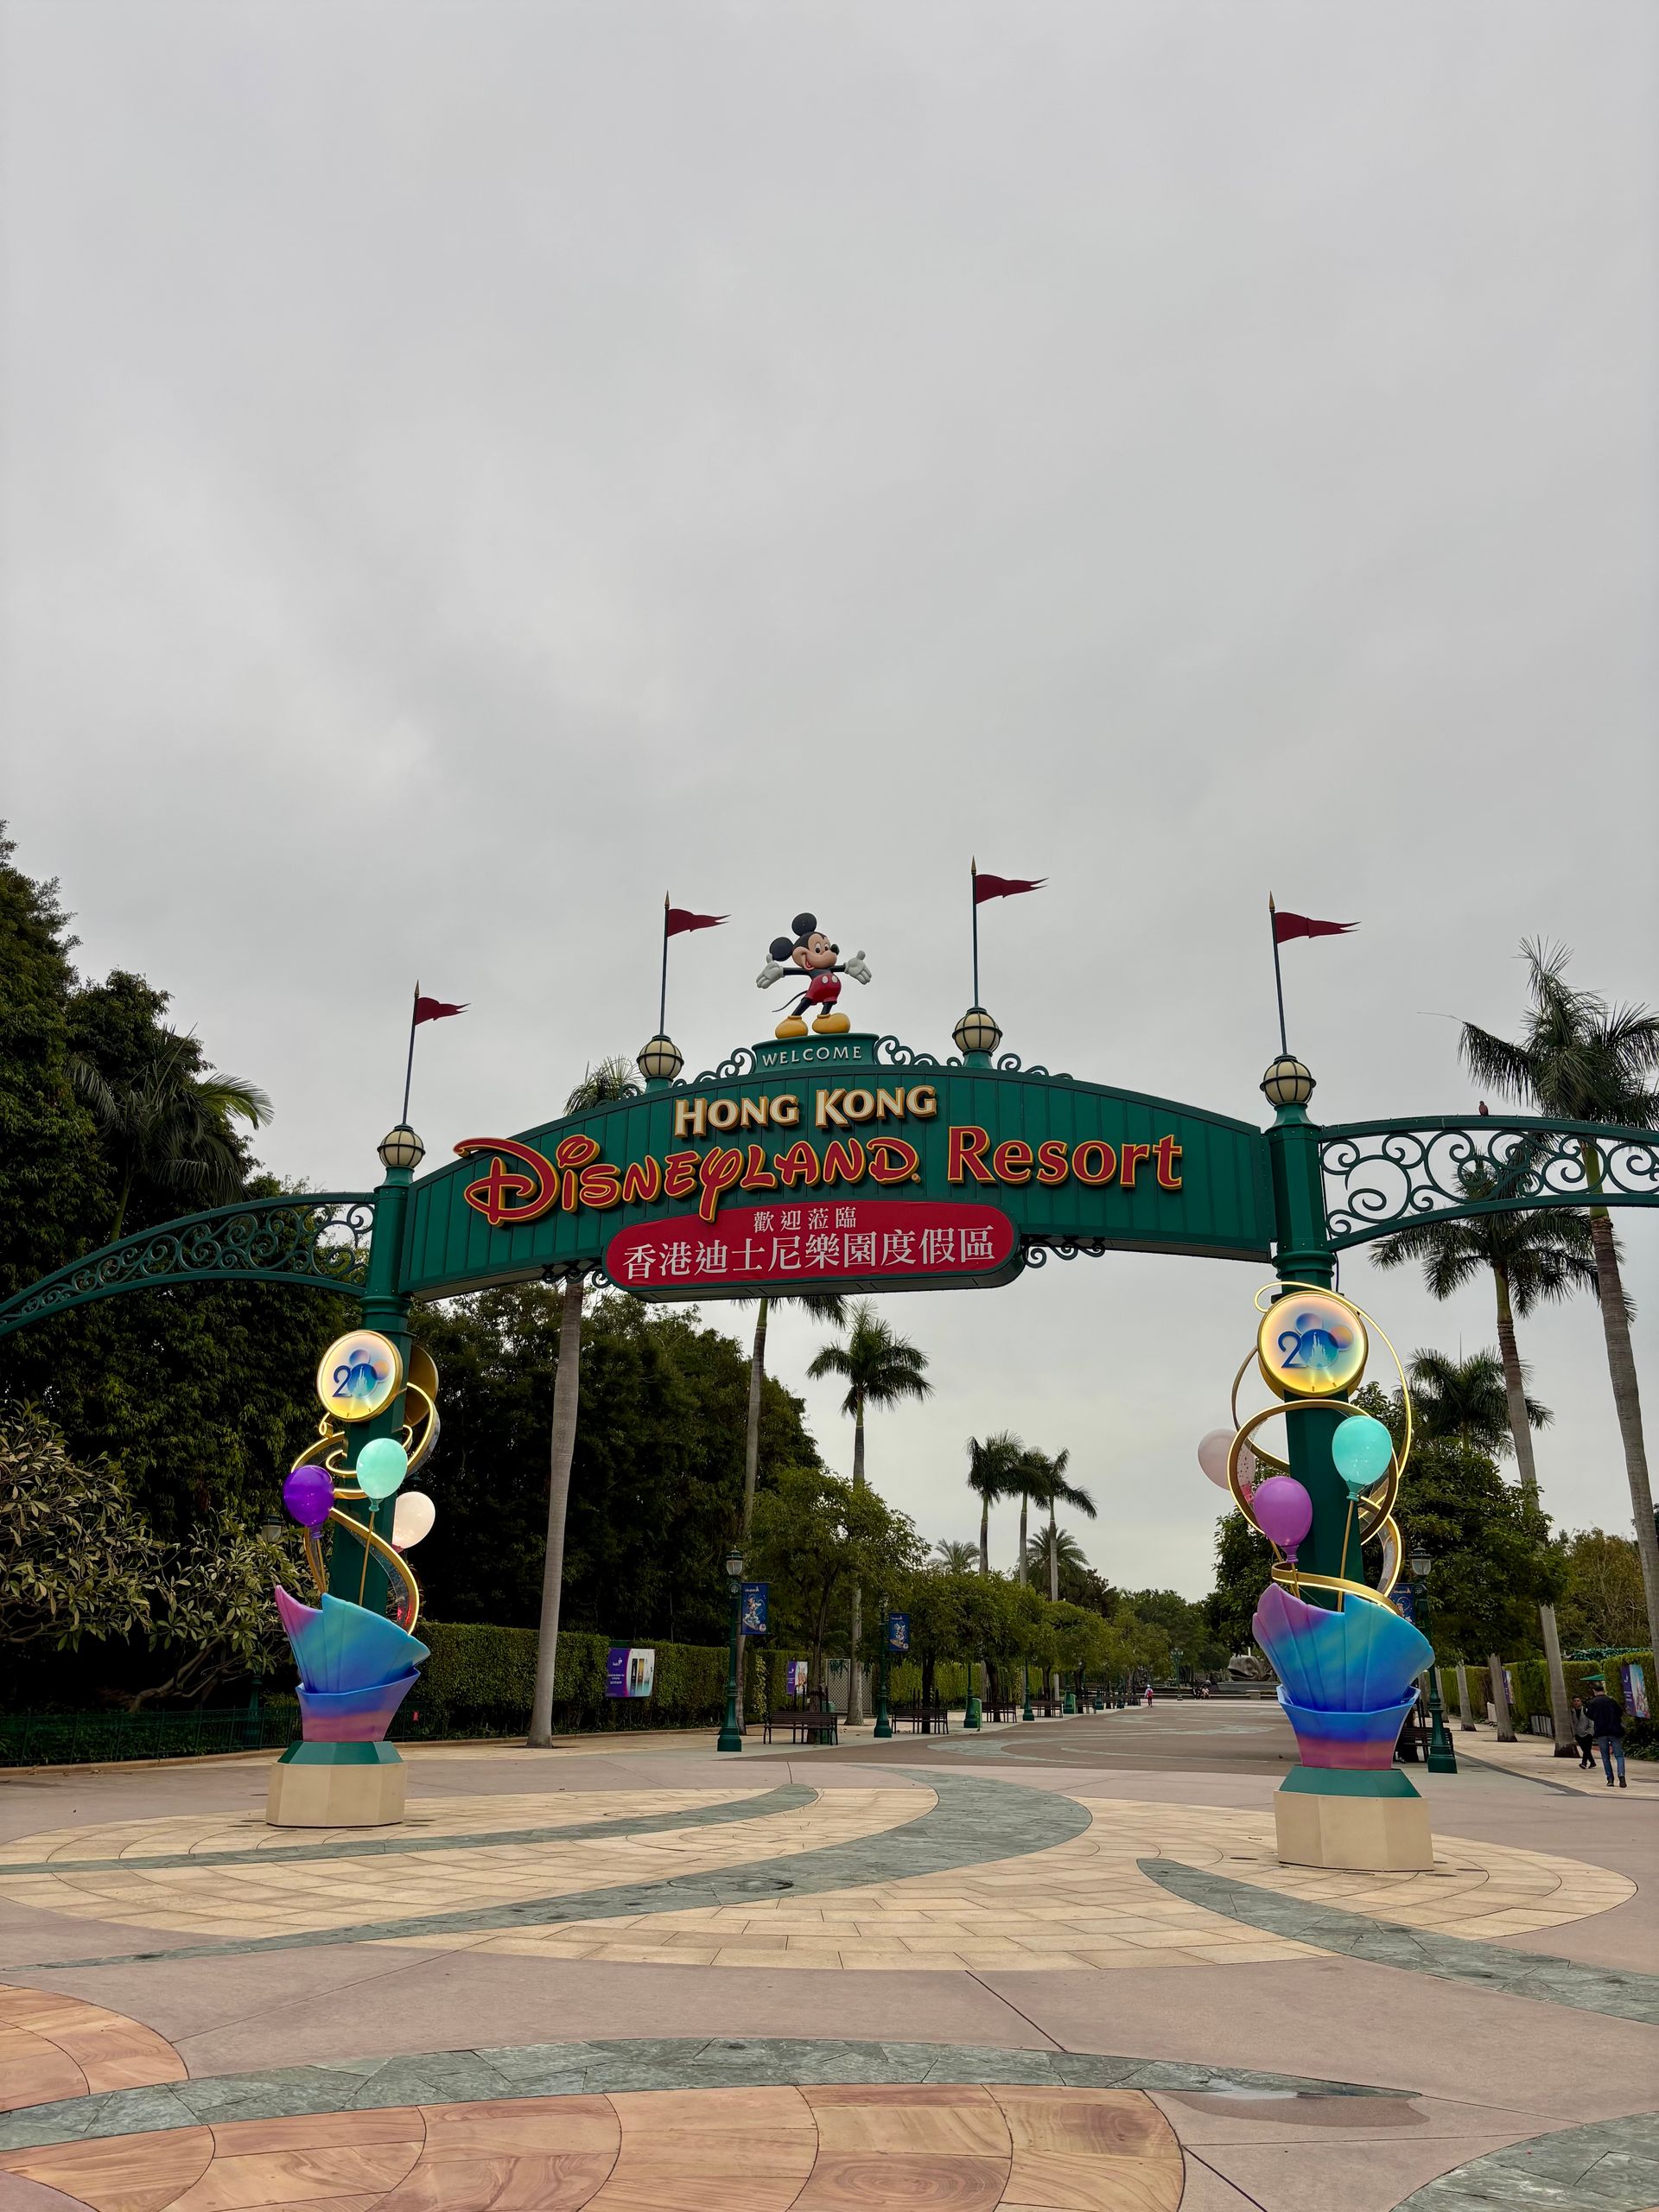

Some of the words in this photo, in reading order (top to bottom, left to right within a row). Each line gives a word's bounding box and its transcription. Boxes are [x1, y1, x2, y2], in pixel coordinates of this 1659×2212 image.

[762, 1046, 862, 1067] WELCOME
[674, 1095, 799, 1136] HONG
[815, 1084, 937, 1128] KONG
[947, 1126, 1183, 1190] Resort
[753, 1206, 857, 1234] 歡迎蒞臨
[622, 1225, 995, 1280] 香港迪士尼樂園度假區
